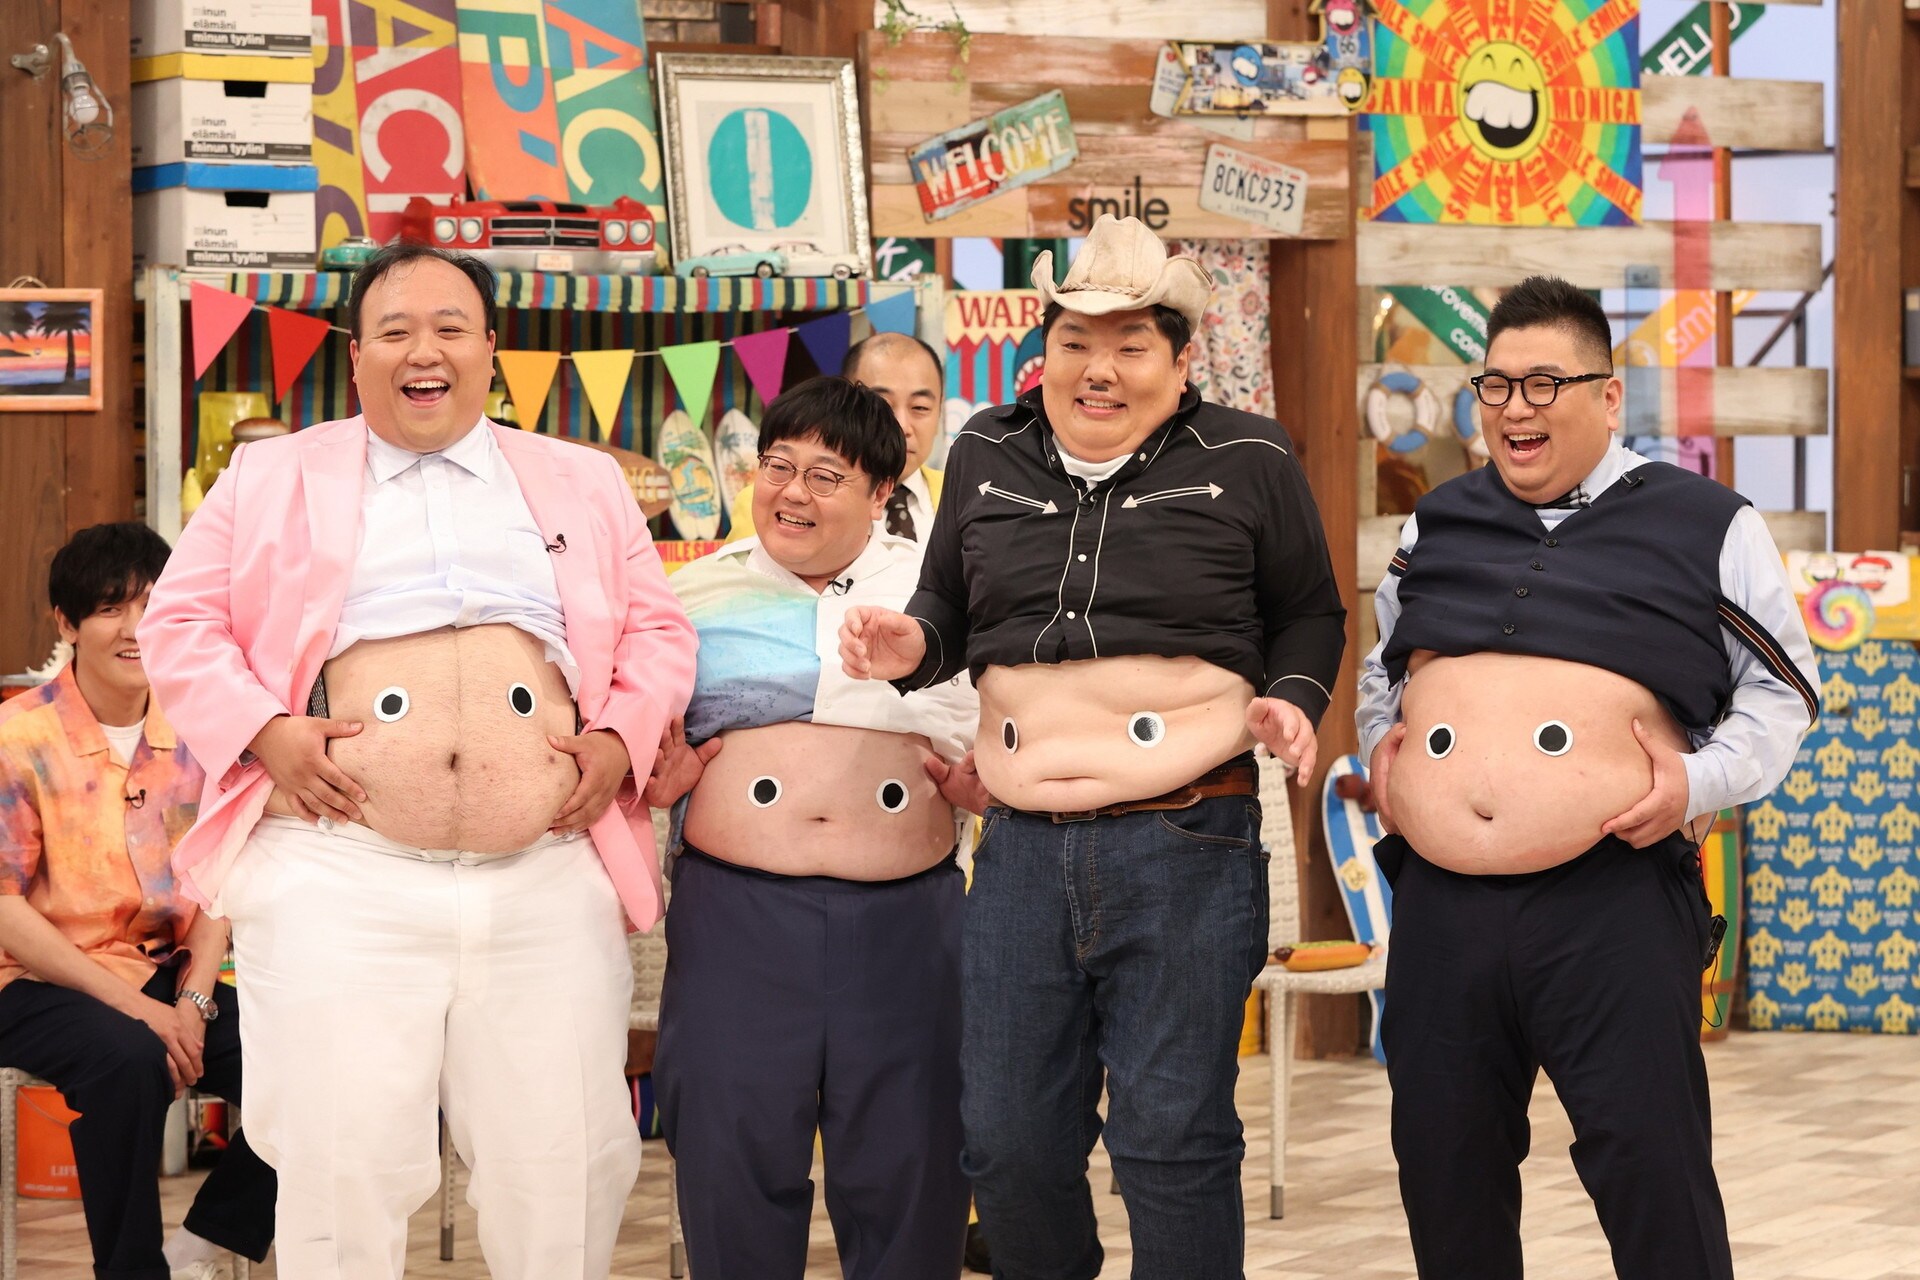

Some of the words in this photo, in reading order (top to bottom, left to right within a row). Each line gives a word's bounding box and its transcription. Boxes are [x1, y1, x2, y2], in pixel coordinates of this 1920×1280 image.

[192, 32, 229, 44] minun
[230, 33, 265, 47] tyylini
[1411, 24, 1460, 73] SMILE
[1521, 0, 1558, 49] SMIL
[1542, 27, 1587, 76] SMILE
[1553, 89, 1638, 123] MONICA
[191, 140, 229, 154] minun
[230, 142, 265, 156] tyylini
[919, 108, 1070, 206] WELCOME
[1412, 129, 1460, 178] SMILE
[1547, 128, 1593, 177] SMILE
[1595, 166, 1641, 215] SMILE
[1213, 163, 1295, 212] 8CKC933
[1446, 152, 1485, 221] SMILE
[1526, 156, 1566, 223] SMILE
[193, 251, 230, 264] minun
[232, 253, 268, 267] tyylini
